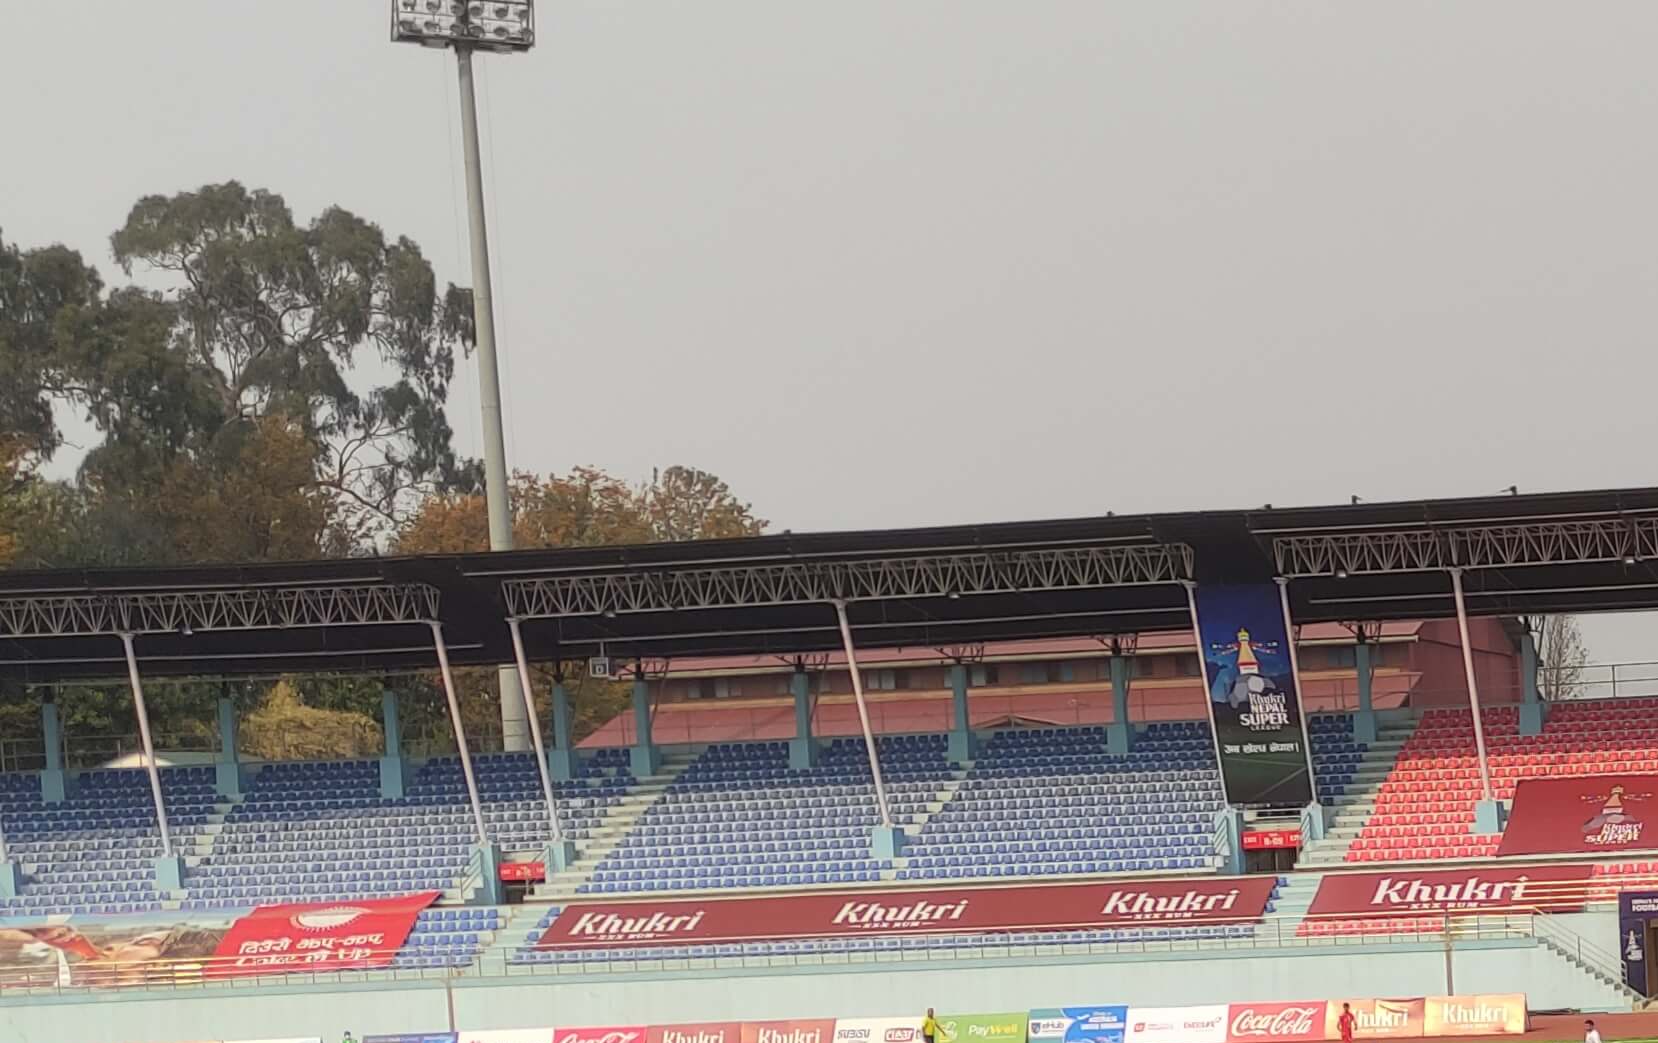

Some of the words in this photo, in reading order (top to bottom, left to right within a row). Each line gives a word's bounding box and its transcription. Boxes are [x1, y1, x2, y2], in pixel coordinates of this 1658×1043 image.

[1240, 713, 1290, 726] SUPER
[1101, 889, 1239, 915] Khukri
[1371, 876, 1528, 905] Khukri
[568, 911, 705, 936] Khukri
[832, 900, 969, 925] Khukri
[1231, 1007, 1318, 1036] Coca-Cola
[1442, 1003, 1508, 1024] Khukri
